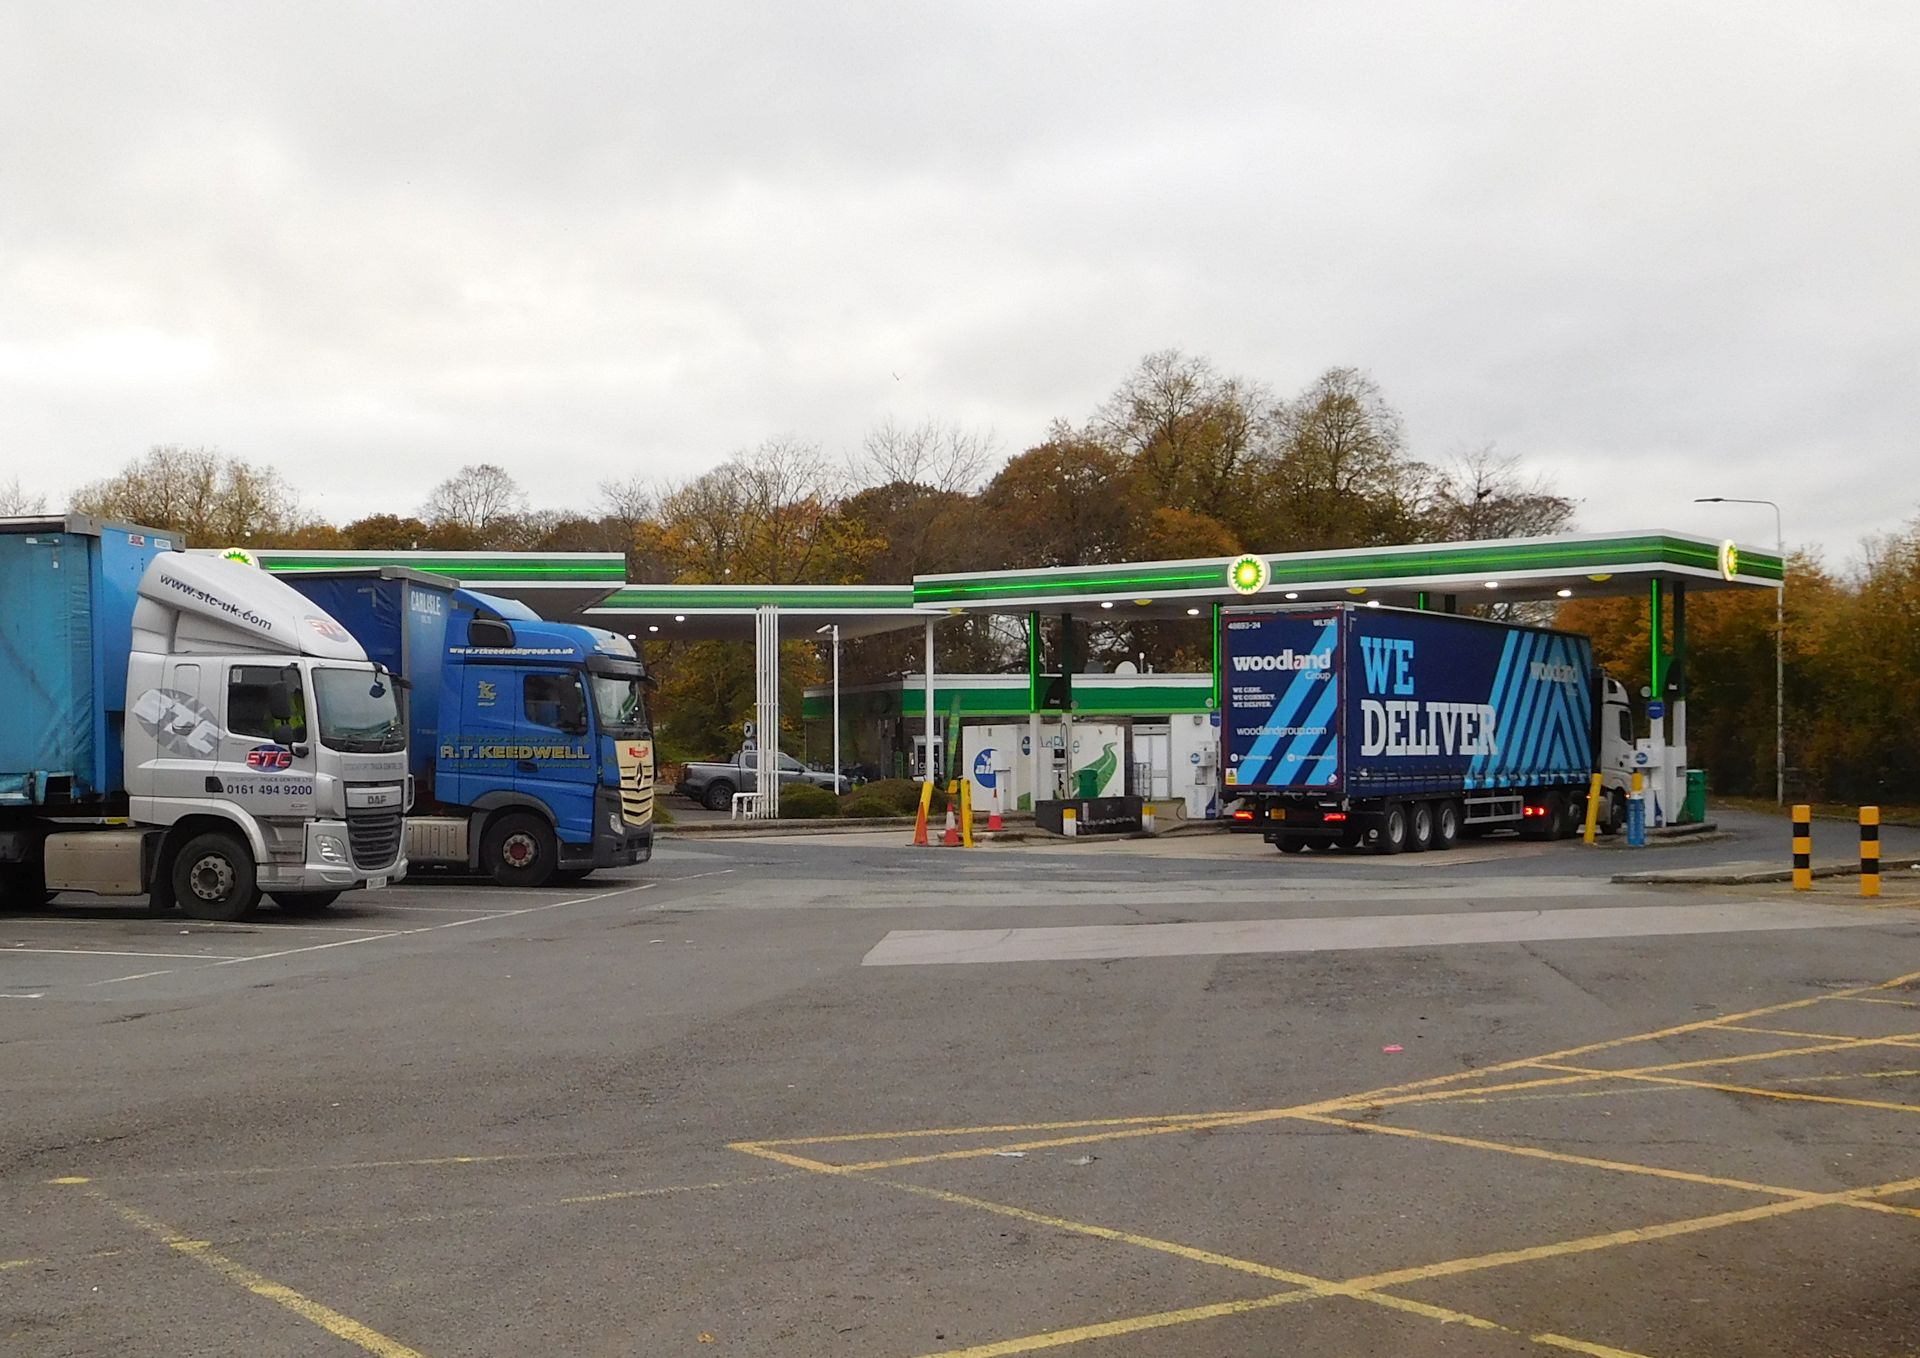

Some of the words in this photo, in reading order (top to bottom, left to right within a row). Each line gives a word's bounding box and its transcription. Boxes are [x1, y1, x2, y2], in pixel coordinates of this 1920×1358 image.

[160, 574, 272, 630] www.stc-uk.com
[411, 591, 441, 615] CARLISLE
[1232, 648, 1331, 671] woodland
[1360, 636, 1414, 695] WE
[1305, 671, 1331, 682] Group
[1236, 726, 1327, 738] woodlandgroup.com
[1361, 699, 1499, 756] DELIVER
[246, 751, 292, 769] STC
[227, 784, 254, 795] 0161
[258, 785, 280, 795] 494
[283, 785, 313, 795] 9200
[367, 795, 388, 805] DAF
